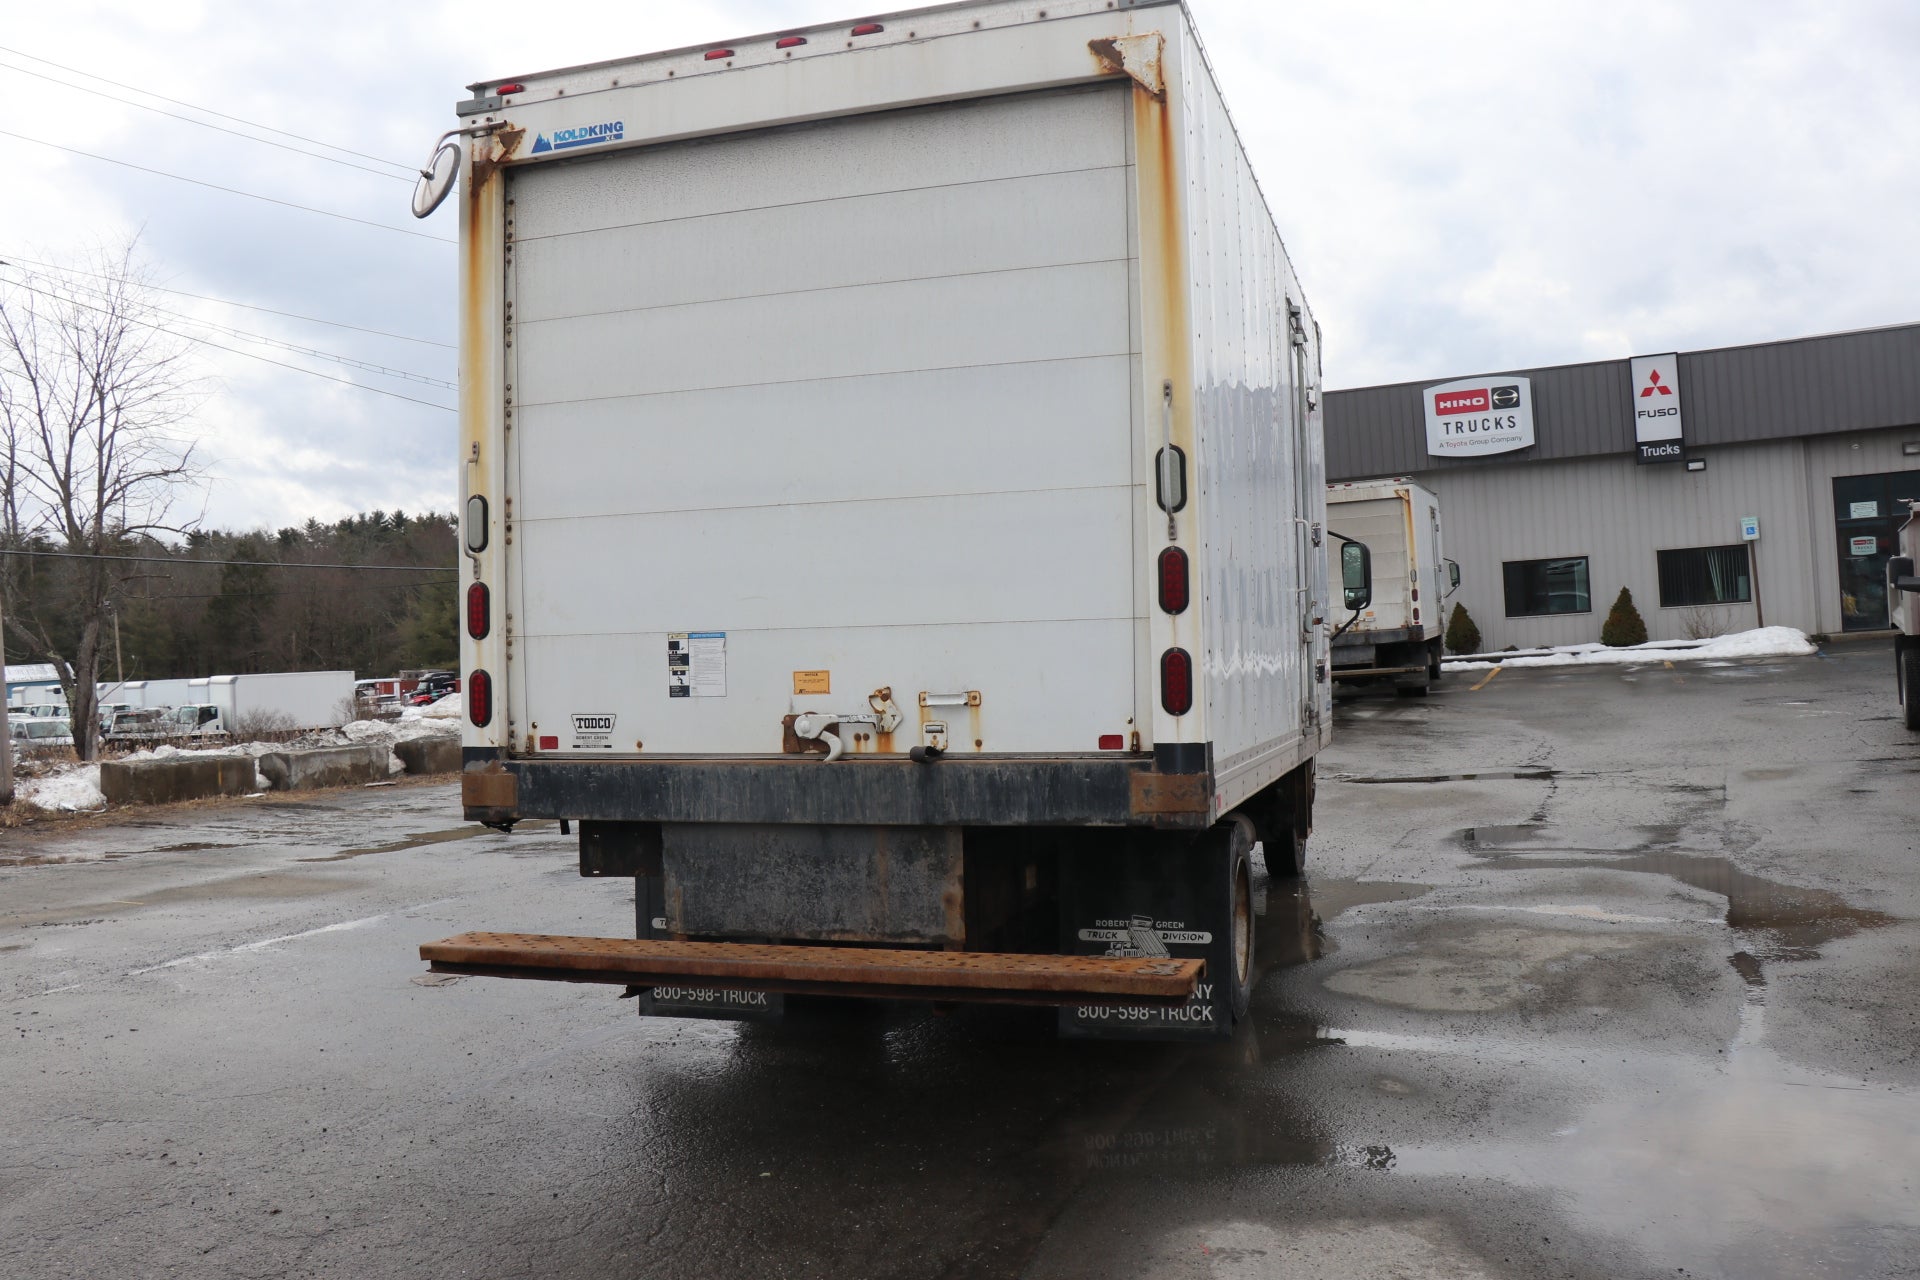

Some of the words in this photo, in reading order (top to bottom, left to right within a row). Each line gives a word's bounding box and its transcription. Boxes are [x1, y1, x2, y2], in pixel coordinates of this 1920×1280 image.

[1439, 397, 1485, 409] HINO
[1637, 407, 1678, 418] FUSO
[1443, 415, 1517, 435] TRUCKS
[1446, 441, 1468, 449] Toyota
[1469, 439, 1490, 447] Group
[1490, 435, 1523, 445] Company
[1640, 444, 1681, 457] Trucks
[575, 717, 611, 729] TODCO
[1096, 919, 1131, 928] ROBERT
[1156, 920, 1185, 929] GREEN
[1087, 930, 1118, 939] TRUCK
[1162, 932, 1205, 941] DIVISION
[653, 986, 767, 1005] 800-598-TRUCK
